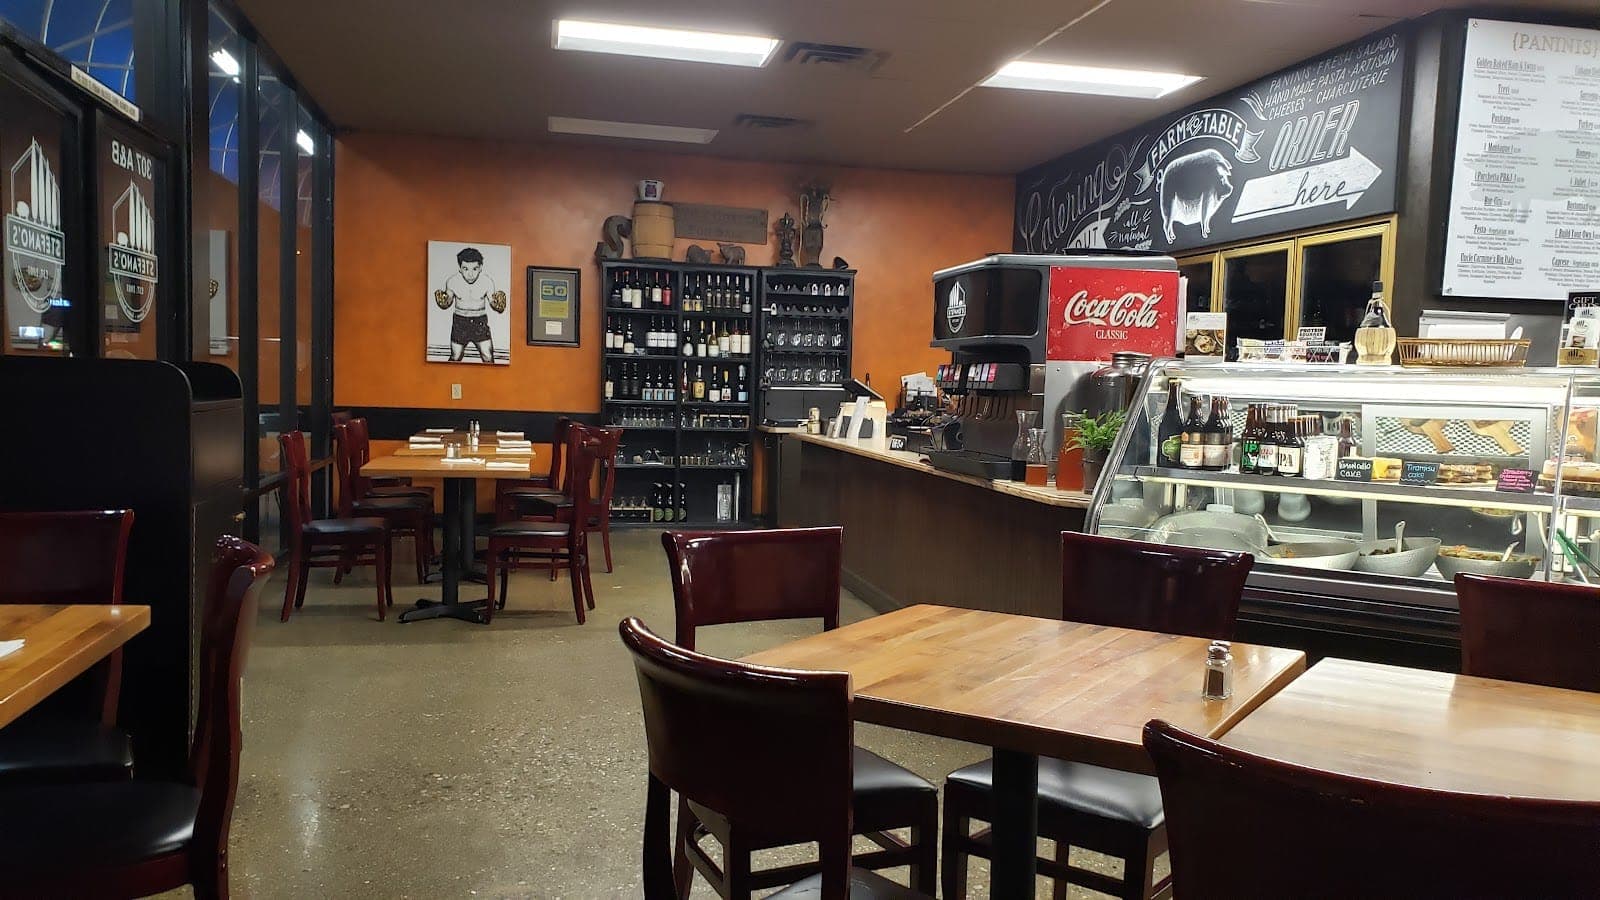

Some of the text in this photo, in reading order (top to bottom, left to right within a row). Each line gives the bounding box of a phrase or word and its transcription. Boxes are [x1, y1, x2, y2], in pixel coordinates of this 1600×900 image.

[1270, 34, 1397, 93] PANINIS FRESH SALADS
[1317, 67, 1347, 88] PASTA
[1351, 48, 1399, 77] ARTISAN
[1268, 68, 1389, 121] CHEESES CHARCUTERIE
[1150, 124, 1187, 167] FARM
[1203, 112, 1243, 144] TABLE
[1269, 100, 1359, 171] ORDER
[1293, 171, 1347, 205] here
[1573, 296, 1596, 304] GIFT
[1096, 329, 1128, 340] CLASSIC
[1406, 463, 1436, 472] Tiramisu
